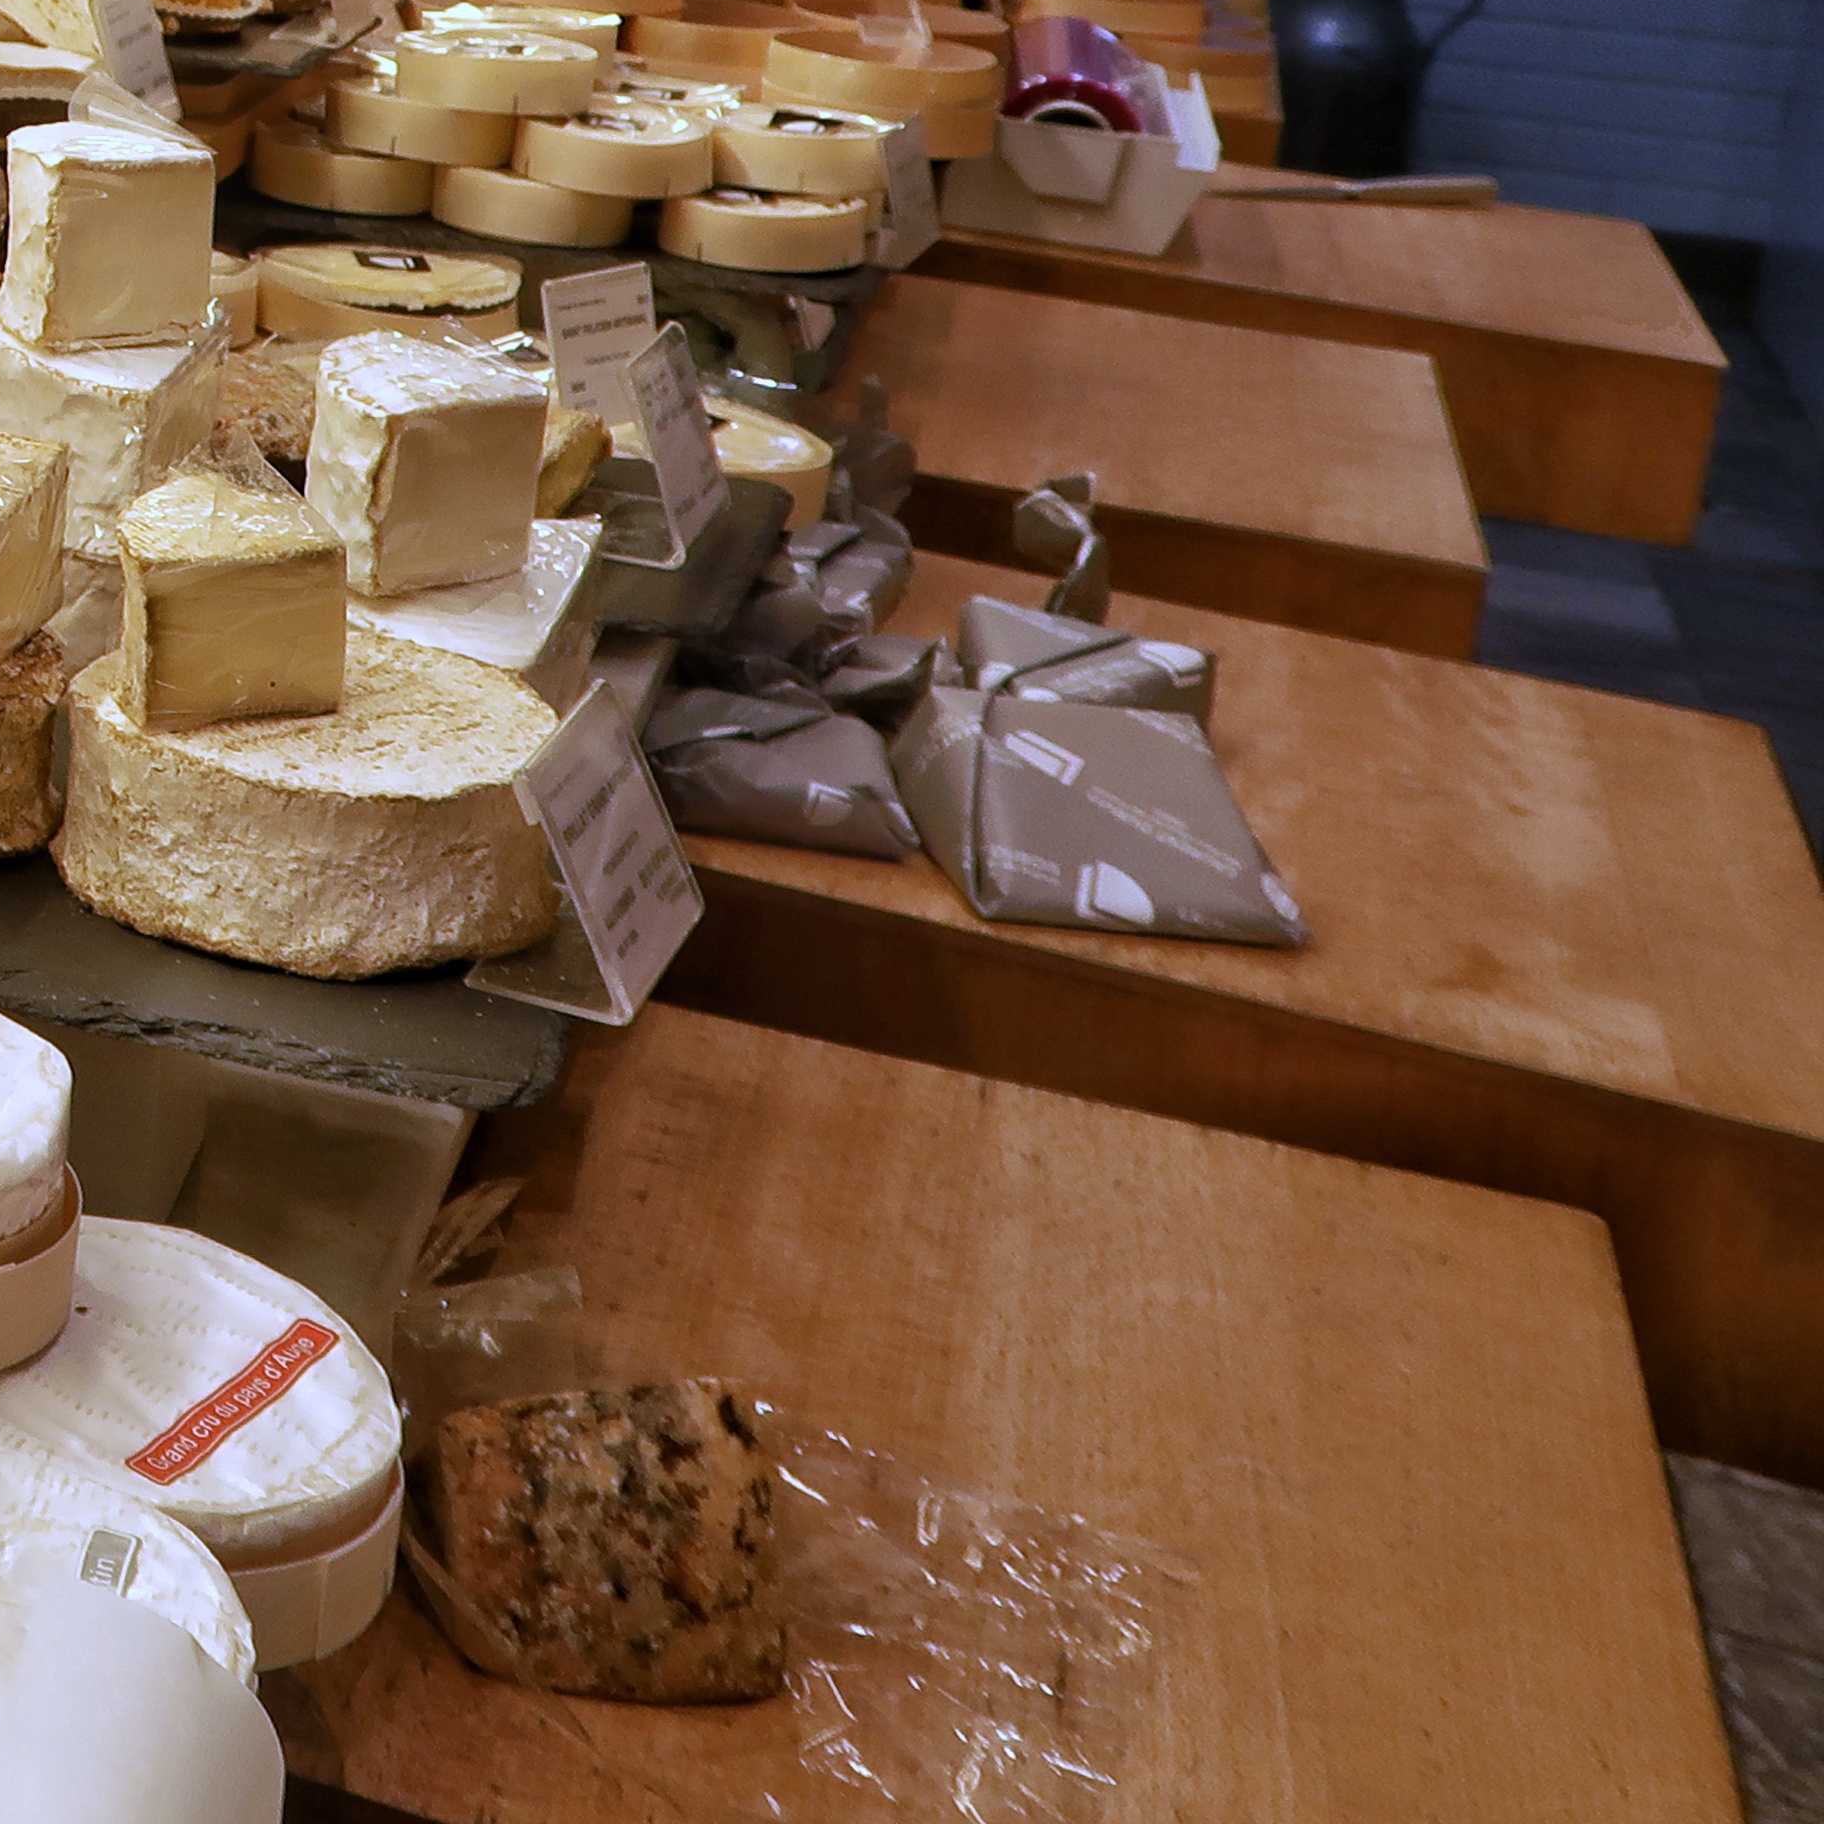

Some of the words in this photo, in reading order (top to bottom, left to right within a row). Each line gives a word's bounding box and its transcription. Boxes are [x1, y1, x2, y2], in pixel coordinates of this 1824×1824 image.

[147, 1434, 199, 1471] Grand
[192, 1414, 221, 1439] cru
[214, 1399, 240, 1419] du
[233, 1377, 272, 1409] pays
[264, 1337, 316, 1380] d'Auge
